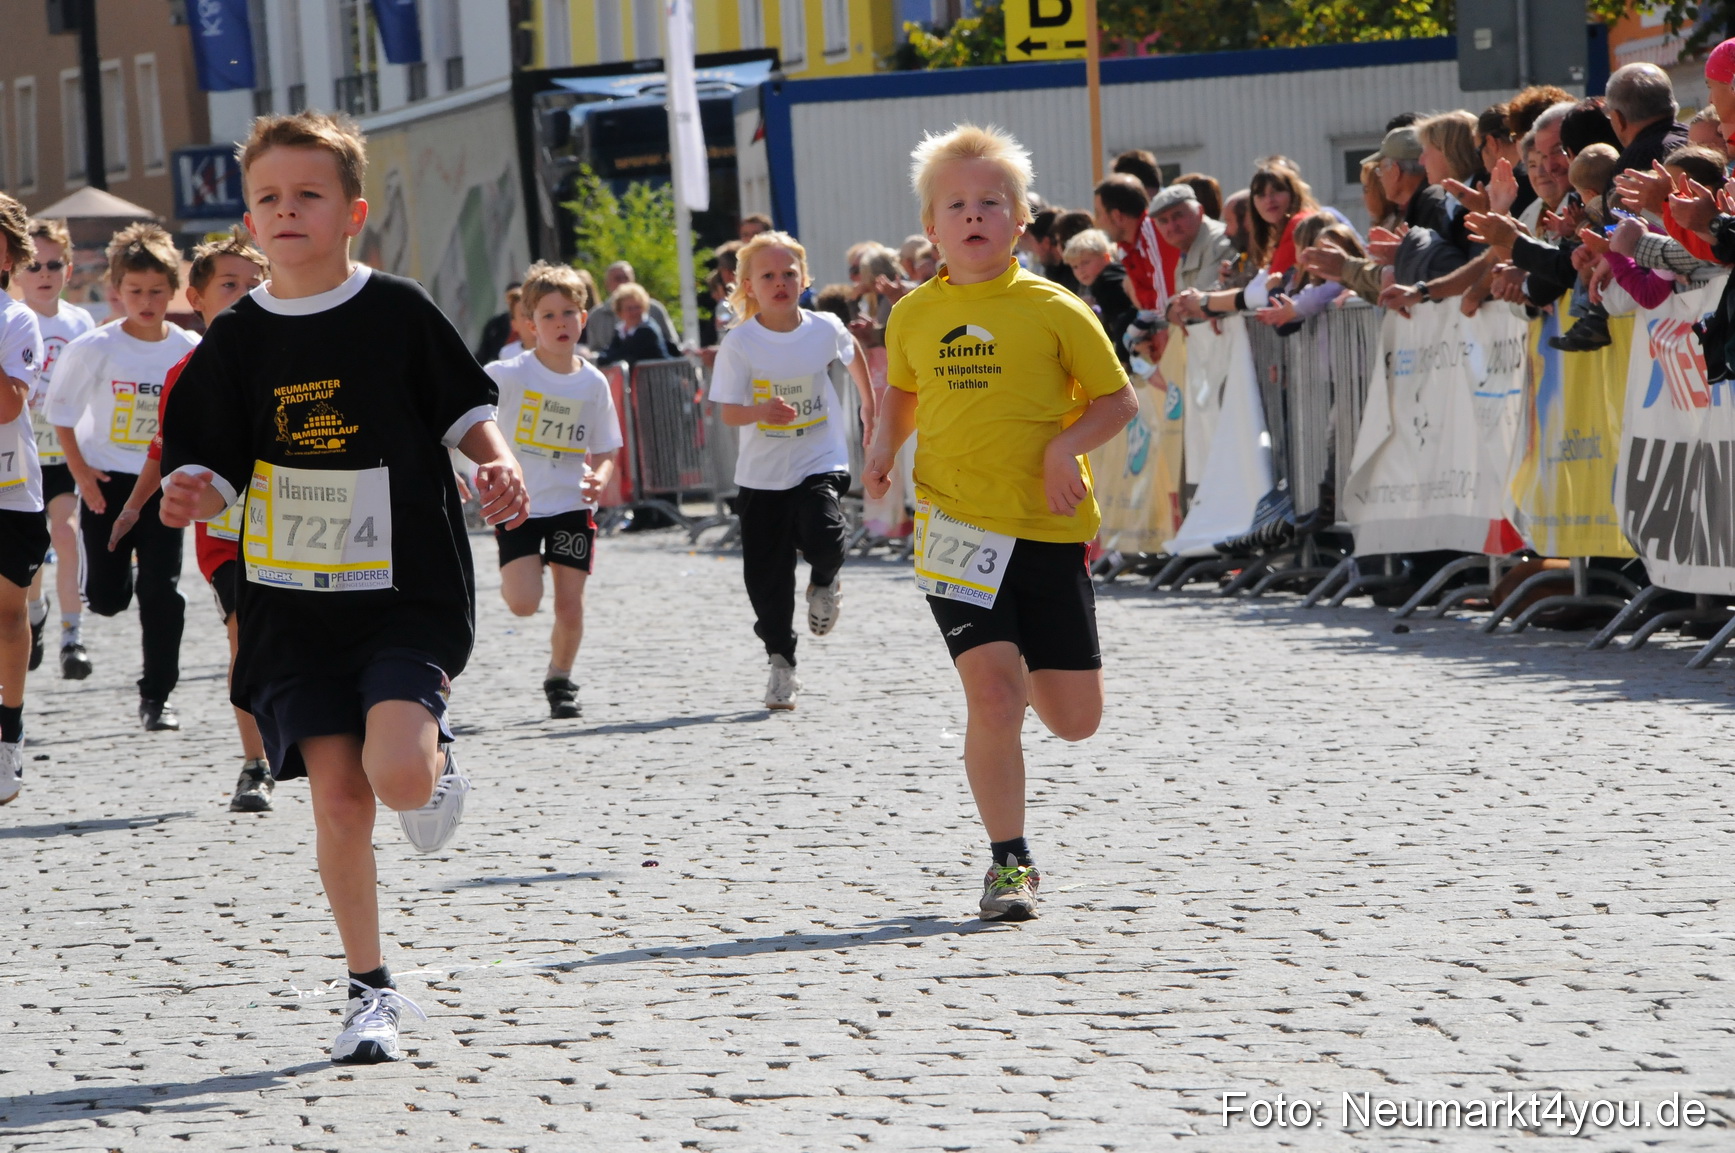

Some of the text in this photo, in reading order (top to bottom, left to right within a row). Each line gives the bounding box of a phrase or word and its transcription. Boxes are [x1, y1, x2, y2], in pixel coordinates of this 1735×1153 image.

[939, 343, 995, 359] skinfit
[934, 363, 1002, 377] TV Hilpoltstein
[273, 379, 341, 397] NEUMARKTER
[773, 384, 803, 396] Tizian
[947, 378, 989, 390] Triathlon
[280, 389, 334, 406] STADTLAUF
[543, 399, 571, 416] Kilian
[790, 395, 823, 418] 084
[135, 418, 158, 434] 72
[291, 425, 359, 441] BAMBINILAUF
[541, 419, 585, 442] 7116
[278, 475, 347, 503] Hannes
[281, 514, 378, 550] 7274
[552, 530, 588, 560] 20
[927, 531, 998, 575] 7273
[331, 569, 389, 582] PFLEIDERER
[947, 583, 994, 602] PFLEIDERER
